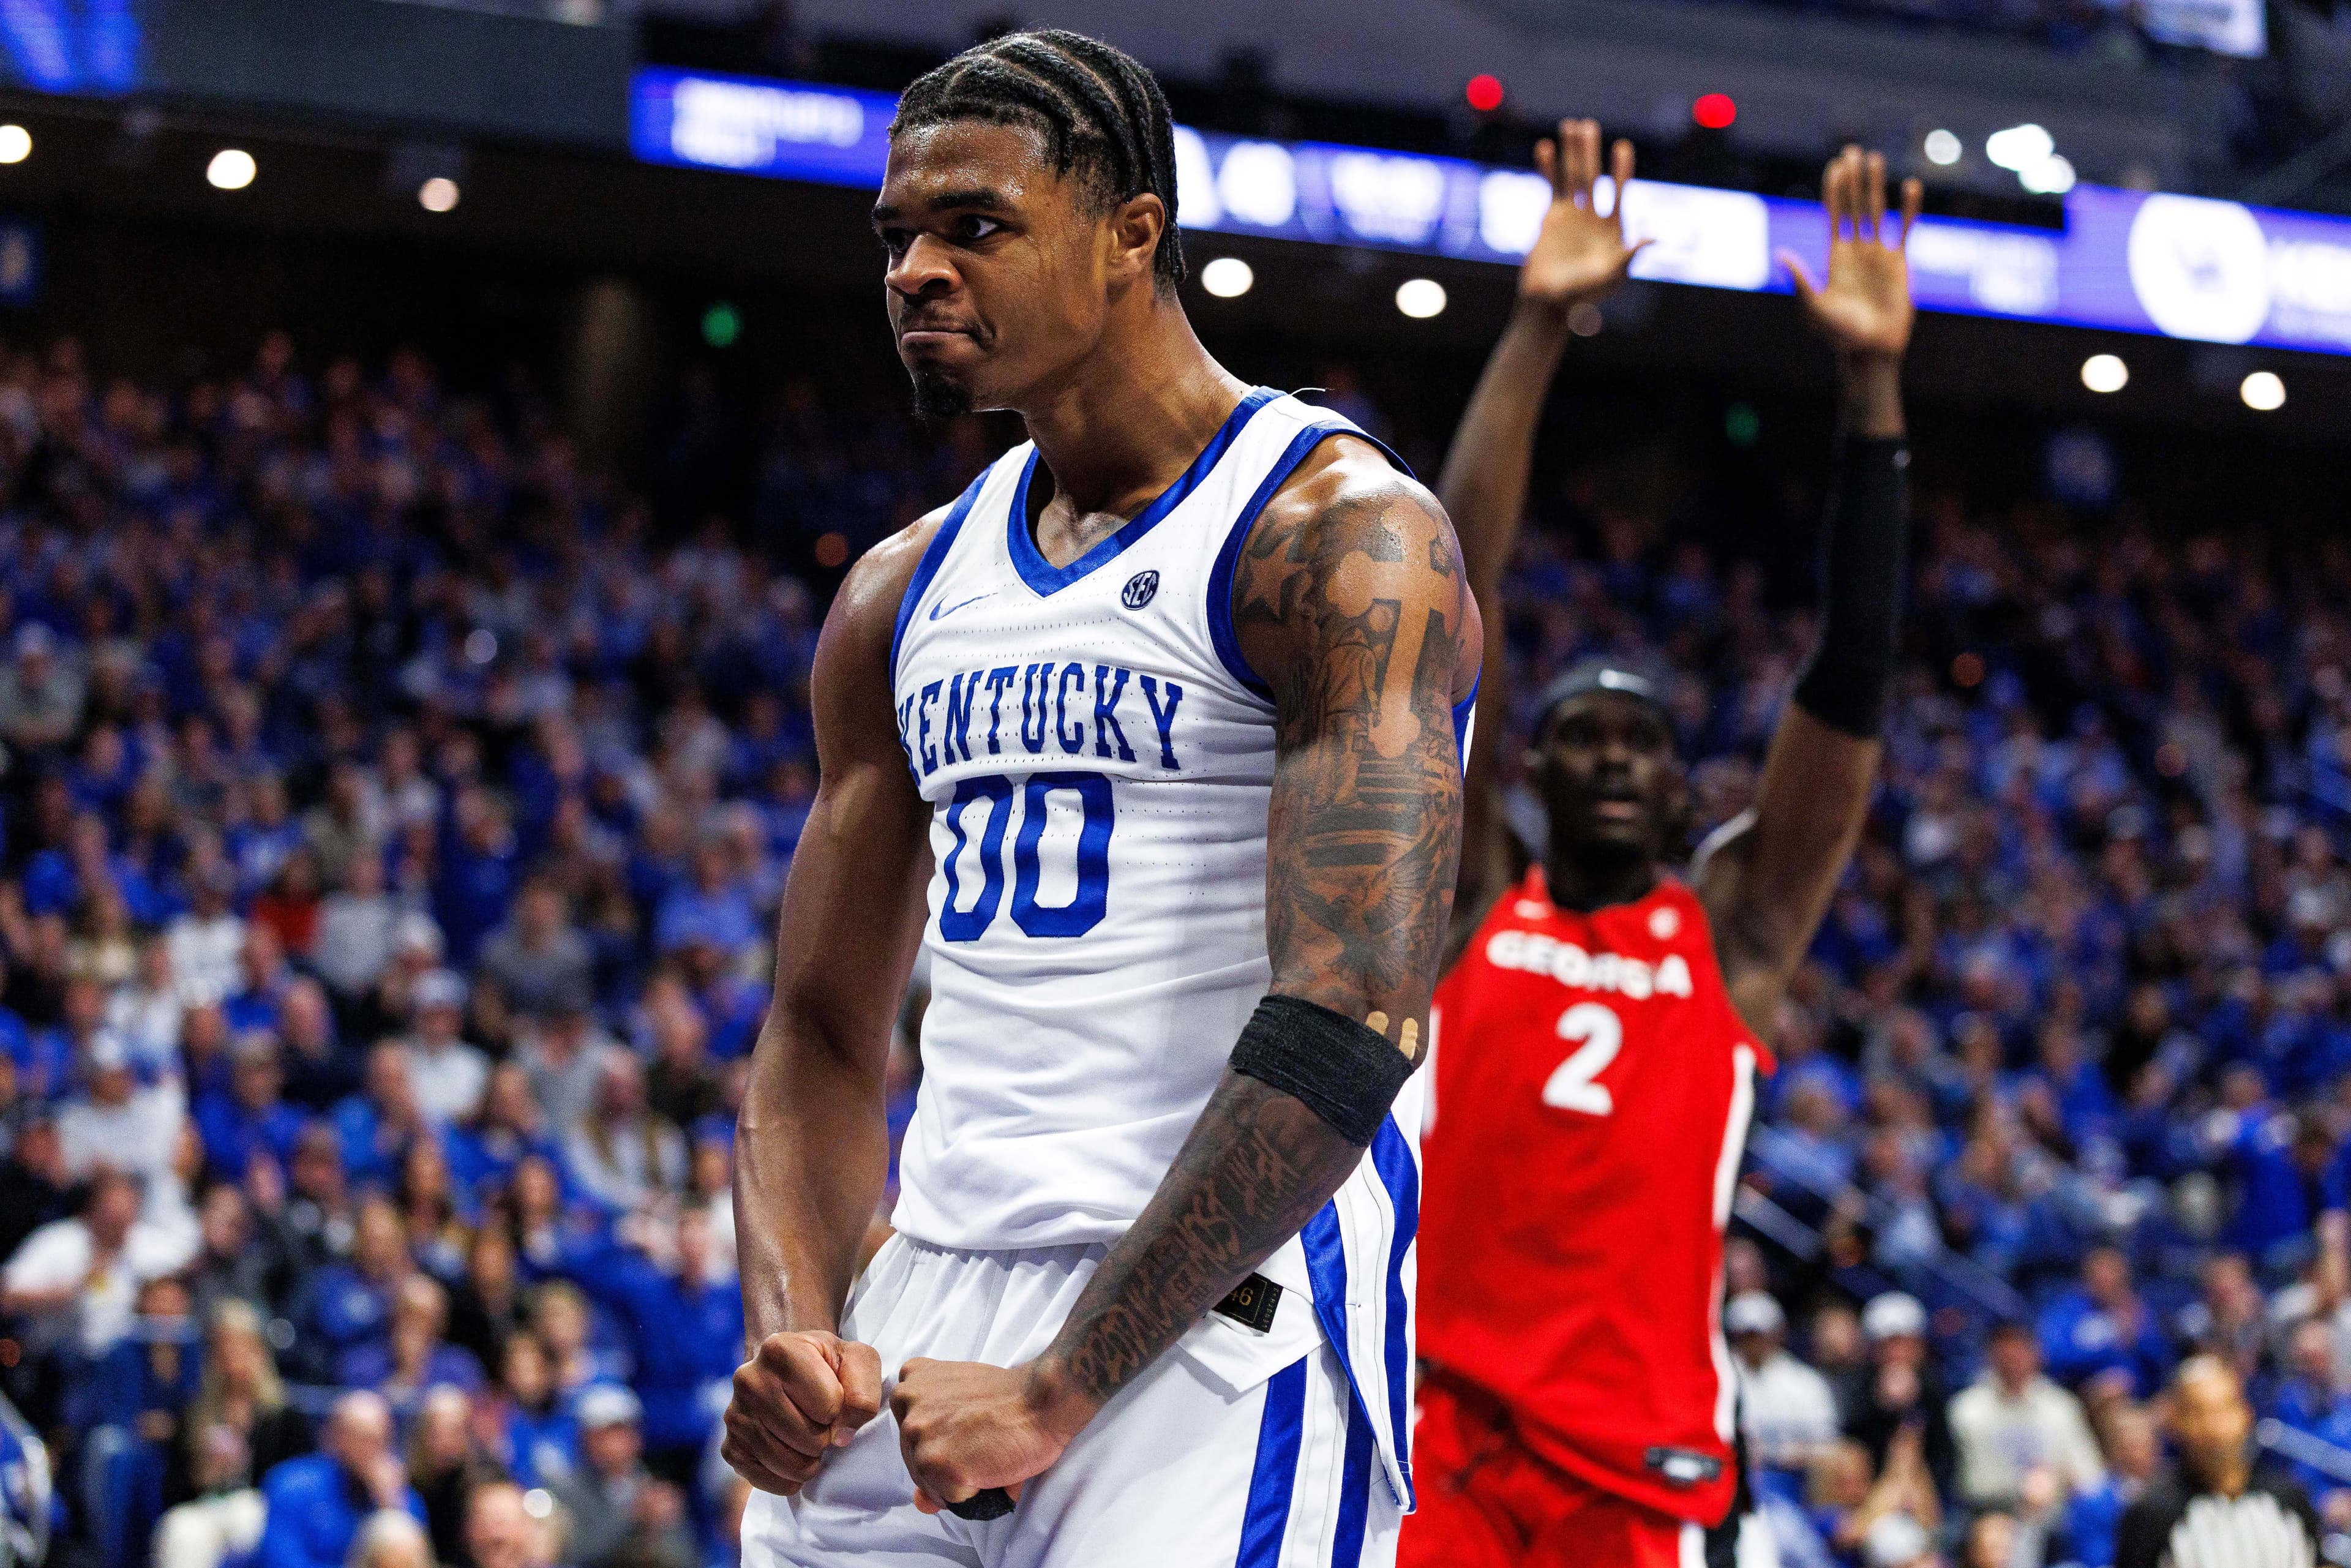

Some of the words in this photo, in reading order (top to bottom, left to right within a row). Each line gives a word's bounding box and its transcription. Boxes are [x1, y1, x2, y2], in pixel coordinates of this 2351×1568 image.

[1123, 572, 1157, 606] SEC
[898, 662, 1183, 787] KENTUCKY
[939, 771, 1114, 942] 00
[1486, 929, 1694, 1000] GEORGIA
[1542, 1001, 1624, 1116] 2
